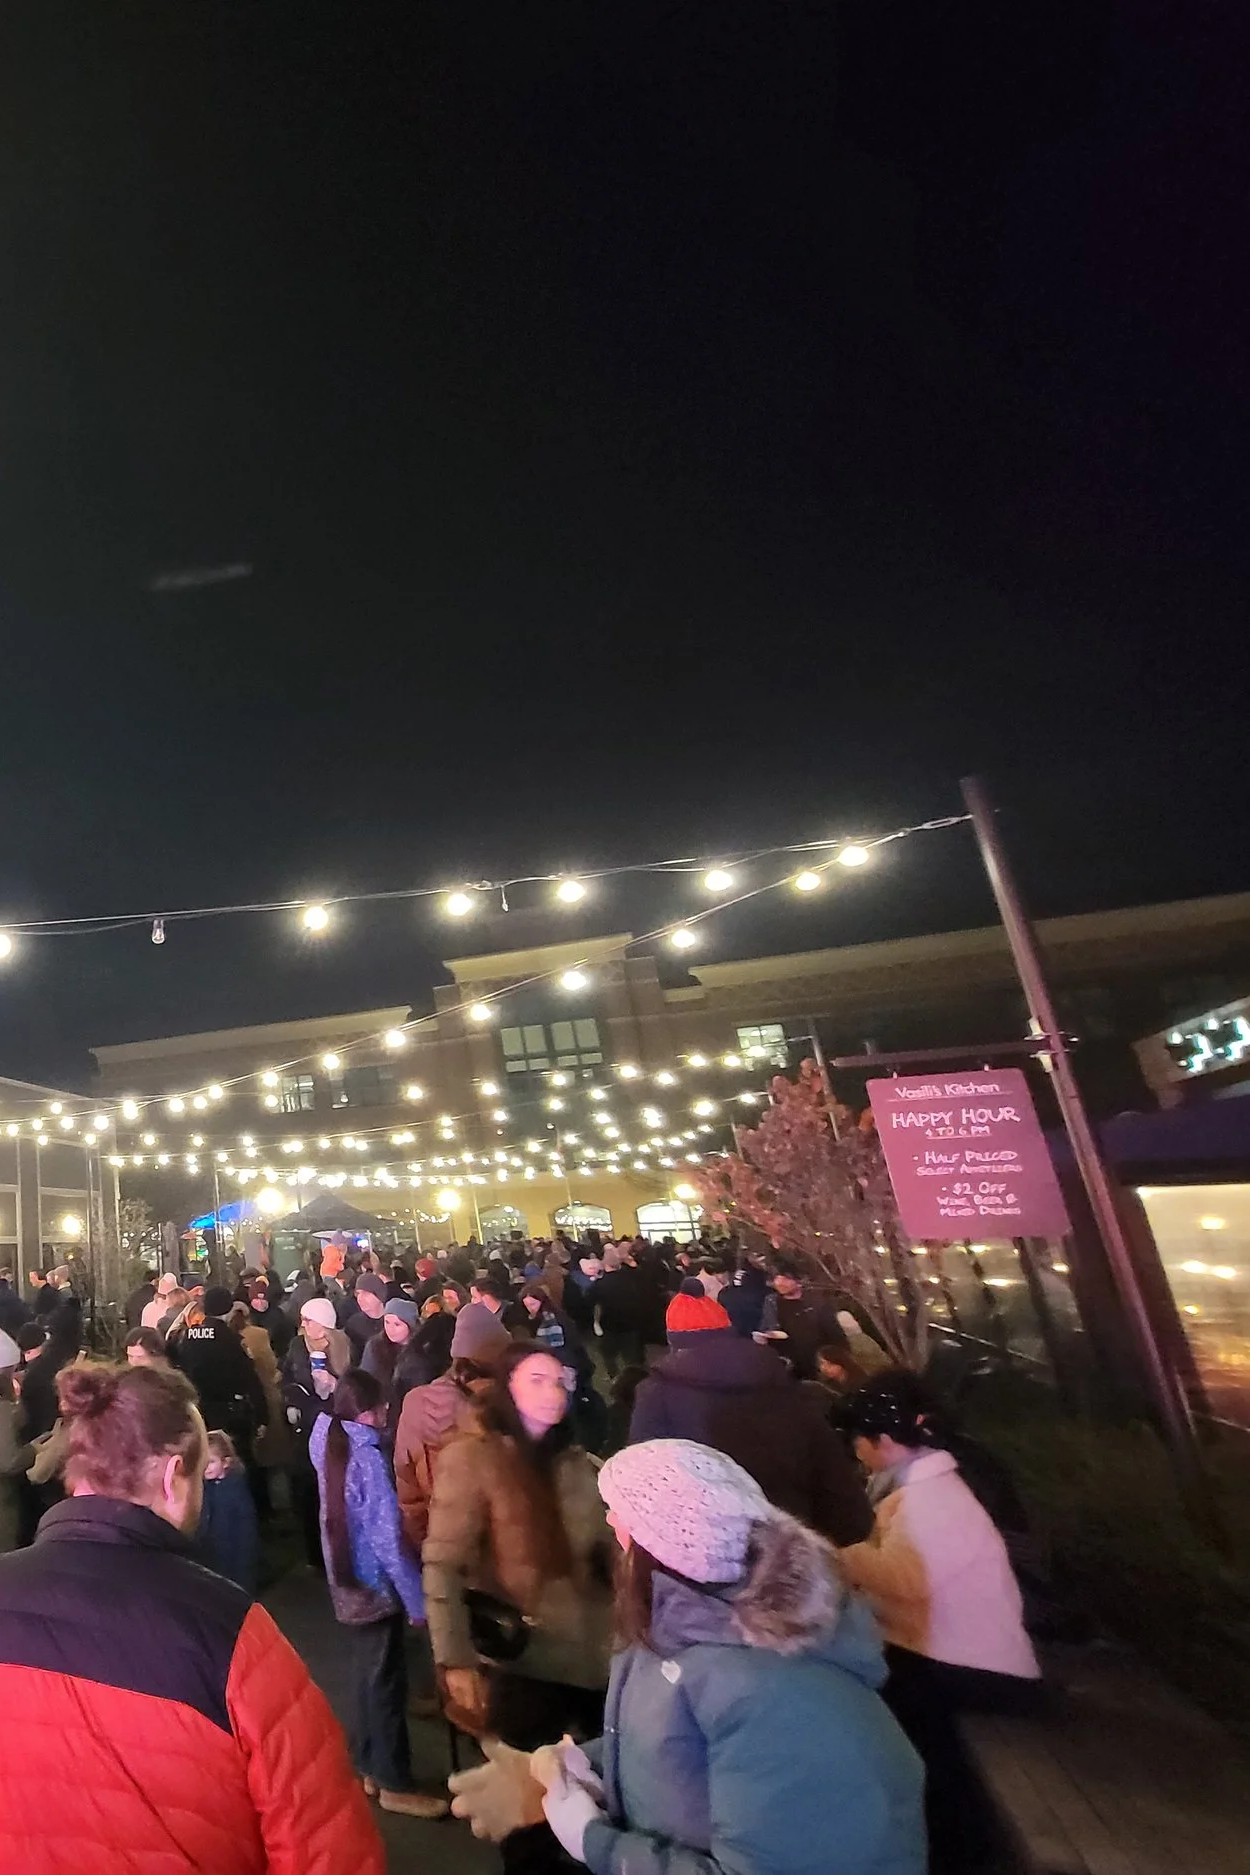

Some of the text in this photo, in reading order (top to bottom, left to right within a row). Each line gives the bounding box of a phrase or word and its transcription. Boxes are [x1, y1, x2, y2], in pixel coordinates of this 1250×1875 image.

[945, 1082, 1000, 1095] Kitchen
[892, 1107, 1021, 1128] HAPPY HOUR
[925, 1125, 990, 1137] 4 TO 6 PM
[952, 1182, 974, 1195] $2
[187, 1327, 215, 1339] POLICE
